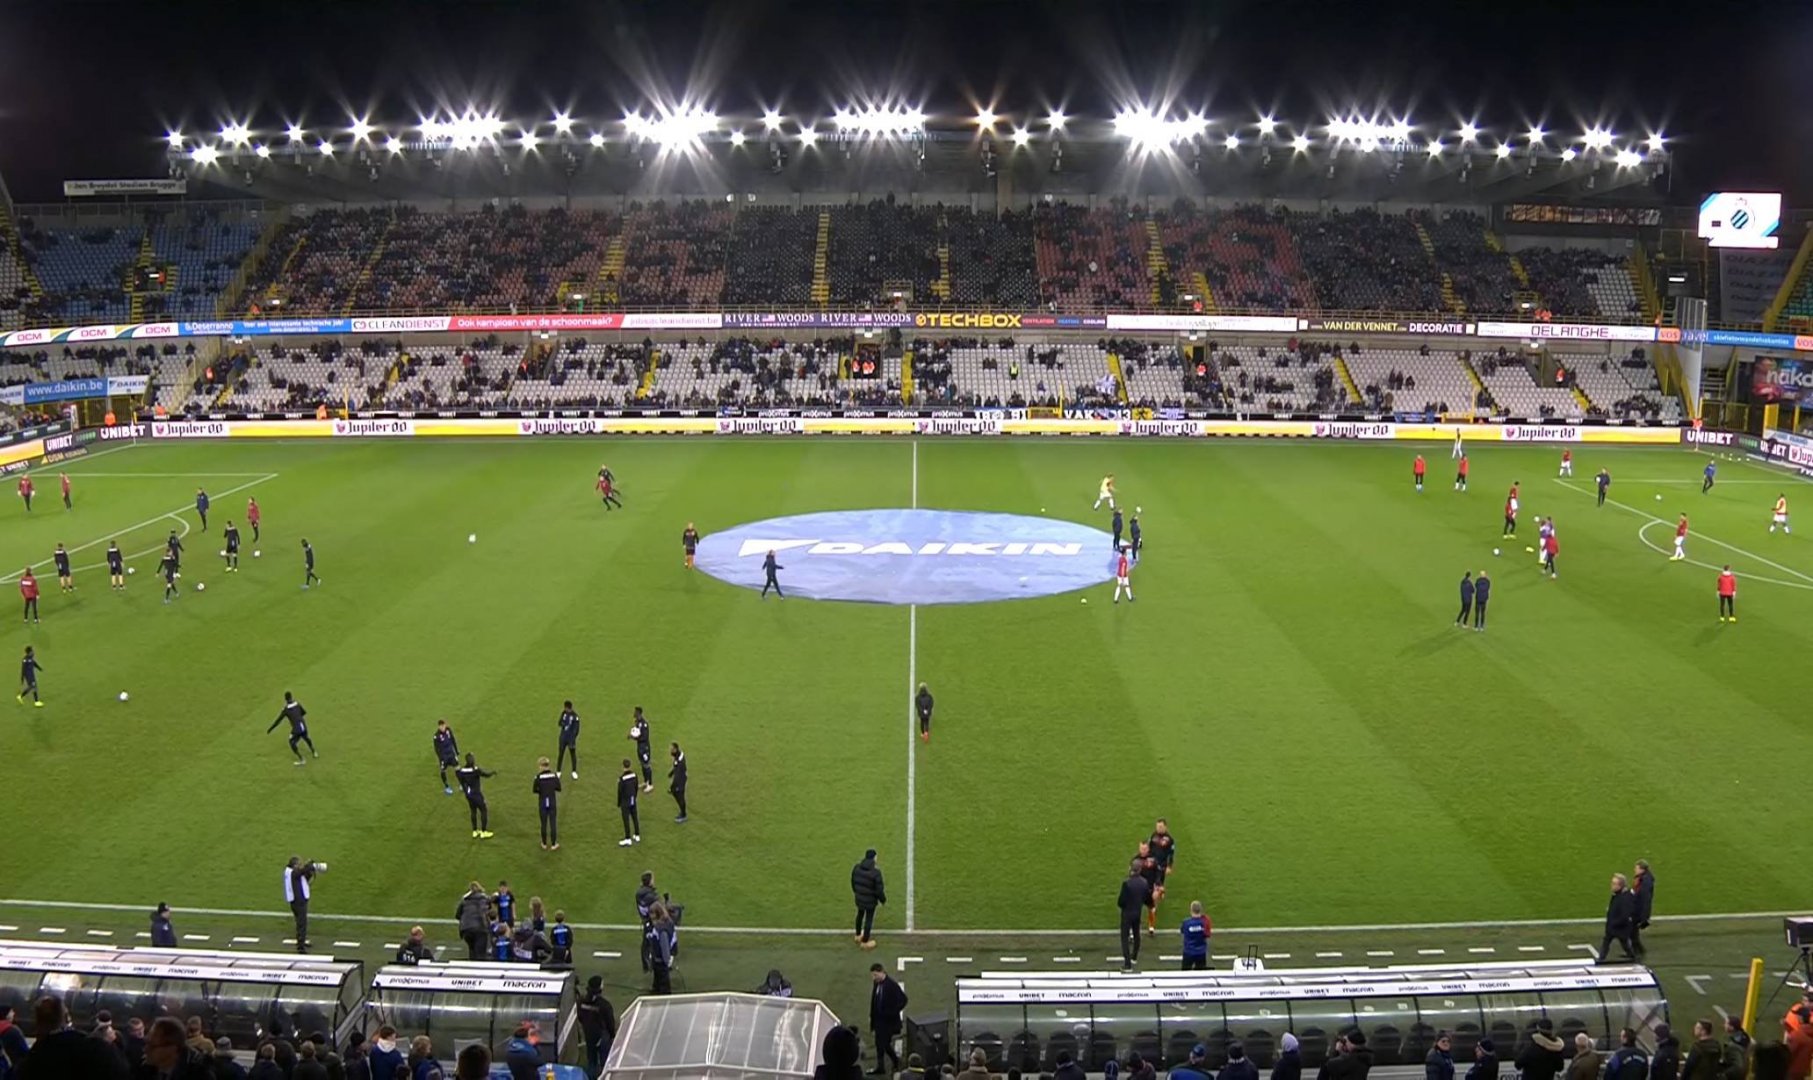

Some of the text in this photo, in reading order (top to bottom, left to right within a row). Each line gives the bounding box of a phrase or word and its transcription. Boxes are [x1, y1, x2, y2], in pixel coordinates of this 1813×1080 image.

[368, 319, 446, 330] CLEANDIENST
[725, 314, 814, 322] RIVER WOODS
[821, 314, 912, 322] RIVER WOODS
[926, 314, 1022, 327] TECHBOX
[1324, 322, 1344, 330] VAN
[1345, 322, 1362, 330] DER
[1364, 322, 1398, 332] VENNET
[1409, 323, 1463, 333] DECORATIE
[1531, 326, 1609, 338] DELANGHE
[27, 381, 104, 396] www.daikin.be
[100, 425, 146, 439] UNIBET
[168, 423, 206, 436] Jupiler
[347, 422, 390, 436] Jupiler
[1329, 424, 1370, 436] Jupiler
[1517, 428, 1558, 440] Jupiler
[47, 435, 72, 451] UNIBET
[1687, 430, 1733, 444] UNIBET
[1760, 440, 1787, 456] UNBET
[808, 542, 1083, 556] DAIKIN
